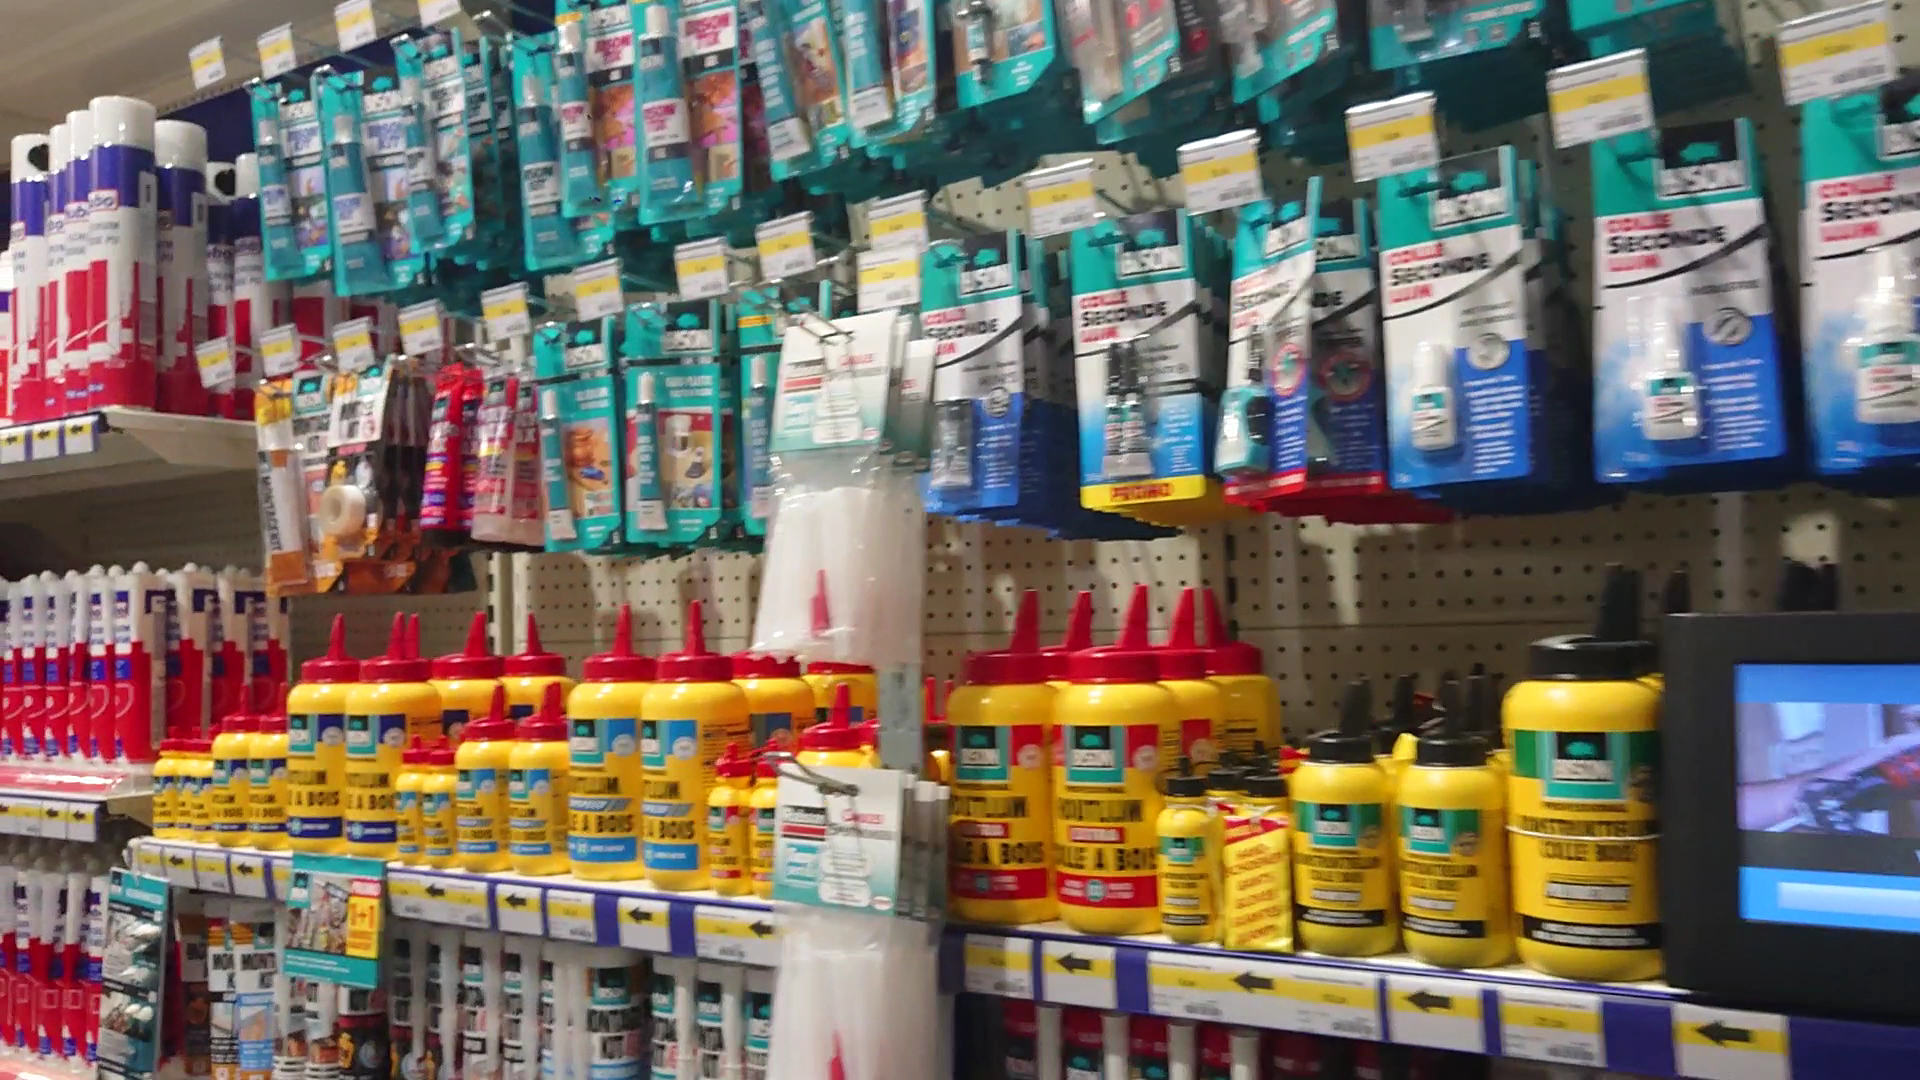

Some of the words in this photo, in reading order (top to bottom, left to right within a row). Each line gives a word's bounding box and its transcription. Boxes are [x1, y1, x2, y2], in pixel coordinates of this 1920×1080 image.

[1608, 226, 1727, 254] SECONDE
[1391, 253, 1489, 286] SECONDE
[1080, 301, 1168, 327] SECONDE
